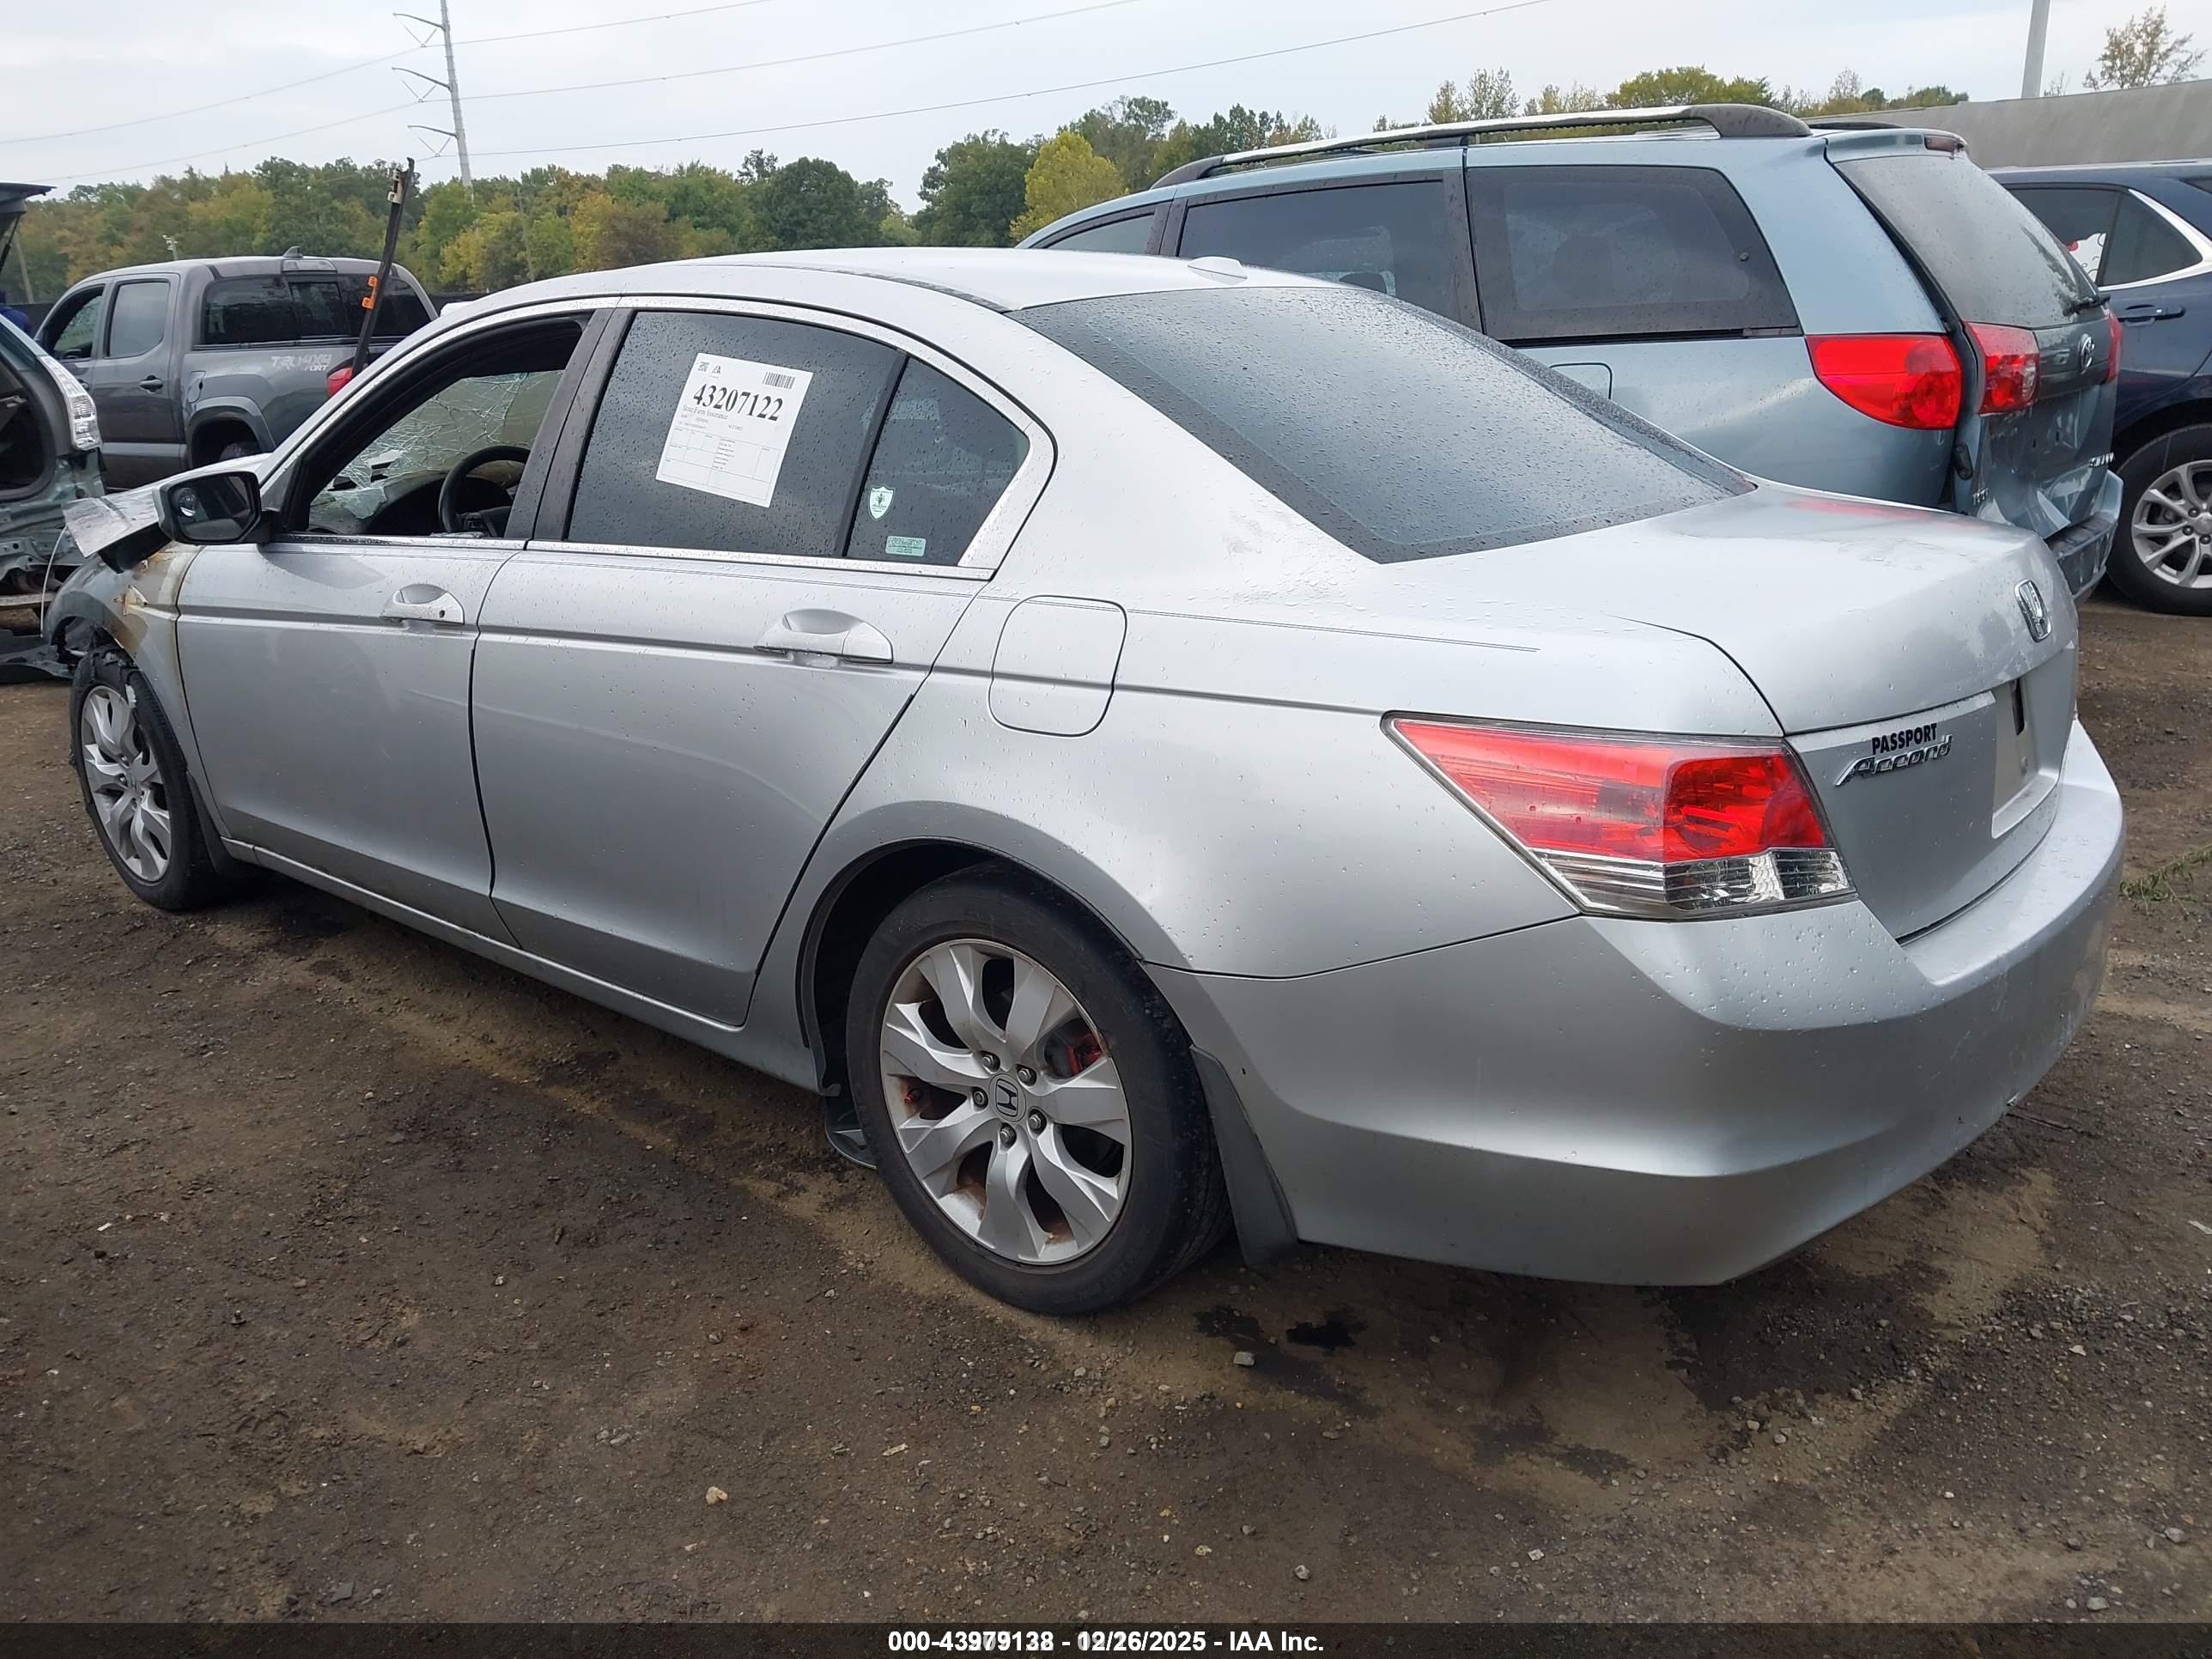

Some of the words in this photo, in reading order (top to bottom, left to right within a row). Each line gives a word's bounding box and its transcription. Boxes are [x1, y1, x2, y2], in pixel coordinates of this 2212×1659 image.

[693, 383, 783, 422] 43207122
[1871, 722, 1938, 756] PASSPORT
[1833, 733, 1954, 787] Accord
